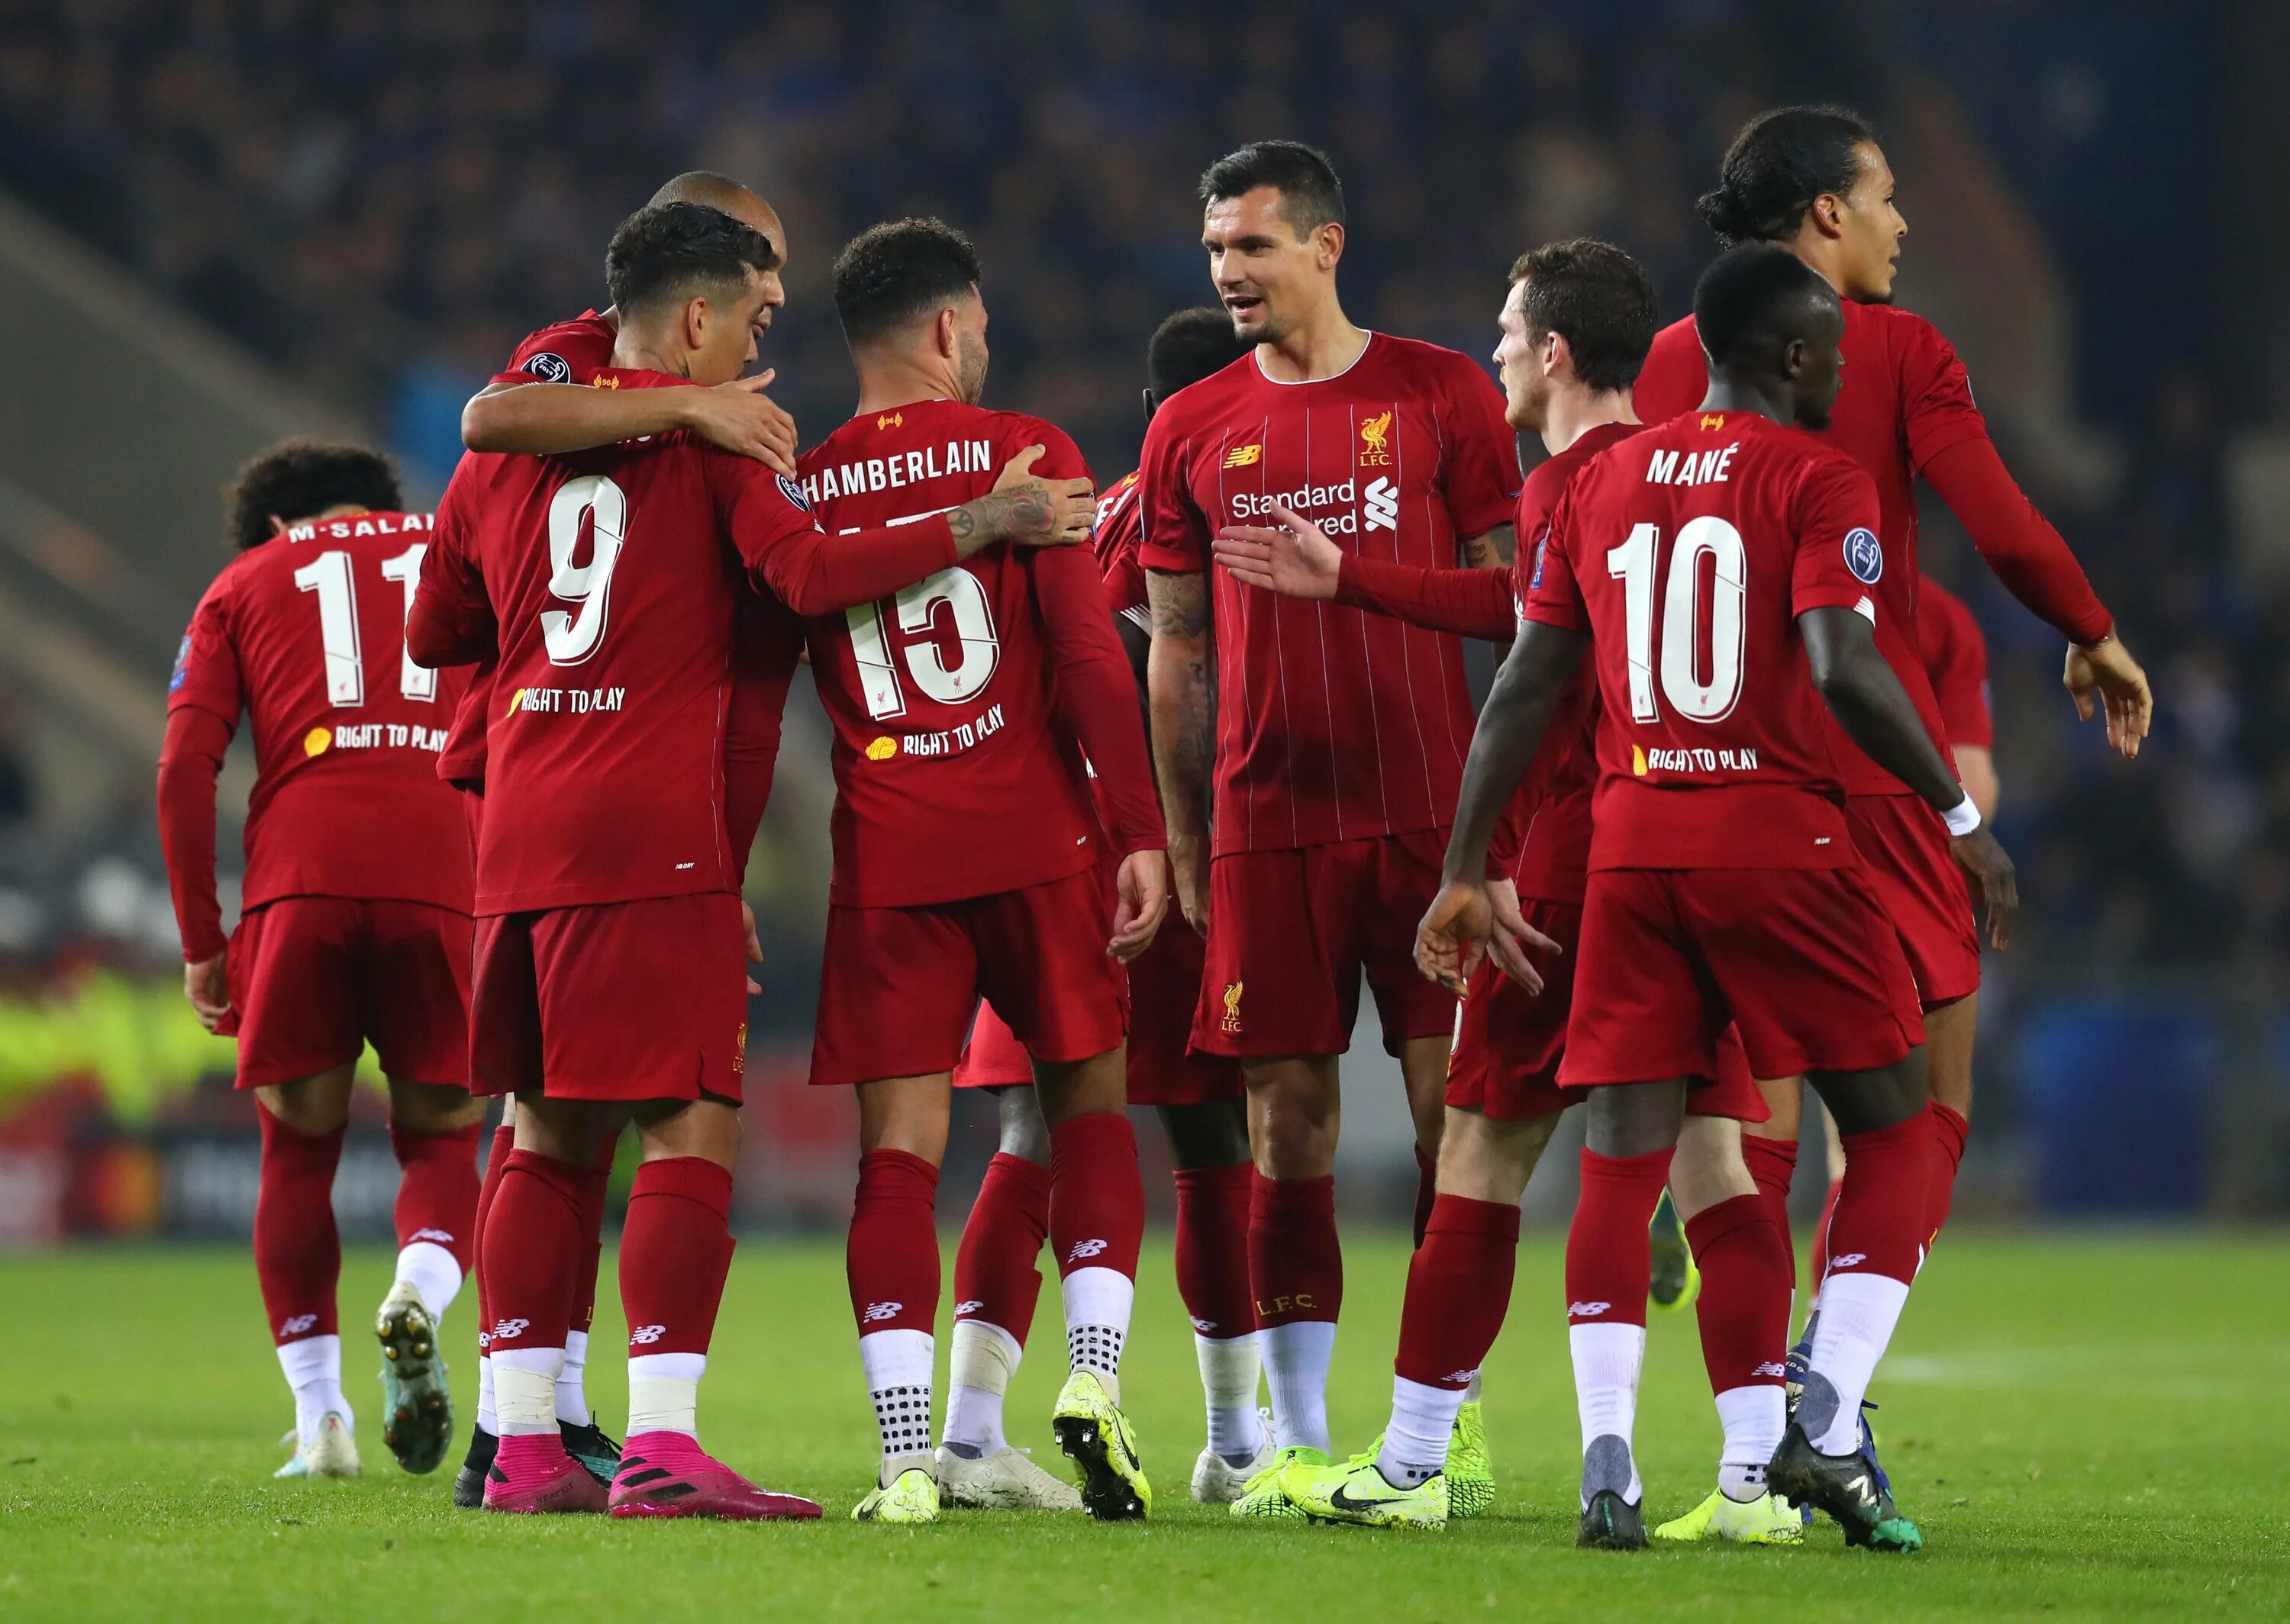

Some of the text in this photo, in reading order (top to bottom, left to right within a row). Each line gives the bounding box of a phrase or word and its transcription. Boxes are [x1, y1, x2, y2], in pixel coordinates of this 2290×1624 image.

[802, 440, 991, 504] HAMBERLAIN
[1645, 442, 1740, 487] MANÉ
[1232, 477, 1356, 519] Standard
[540, 475, 627, 667] 9
[294, 543, 440, 708] 11
[839, 505, 1001, 722] 15
[1607, 516, 1747, 725] 10
[521, 688, 626, 714] RIGHT TO PLAY
[336, 724, 449, 753] RIGHT TO PLAY
[903, 703, 1005, 756] RIGHT TO PLAY
[1692, 749, 1716, 772] TO
[1719, 748, 1758, 770] PLAY
